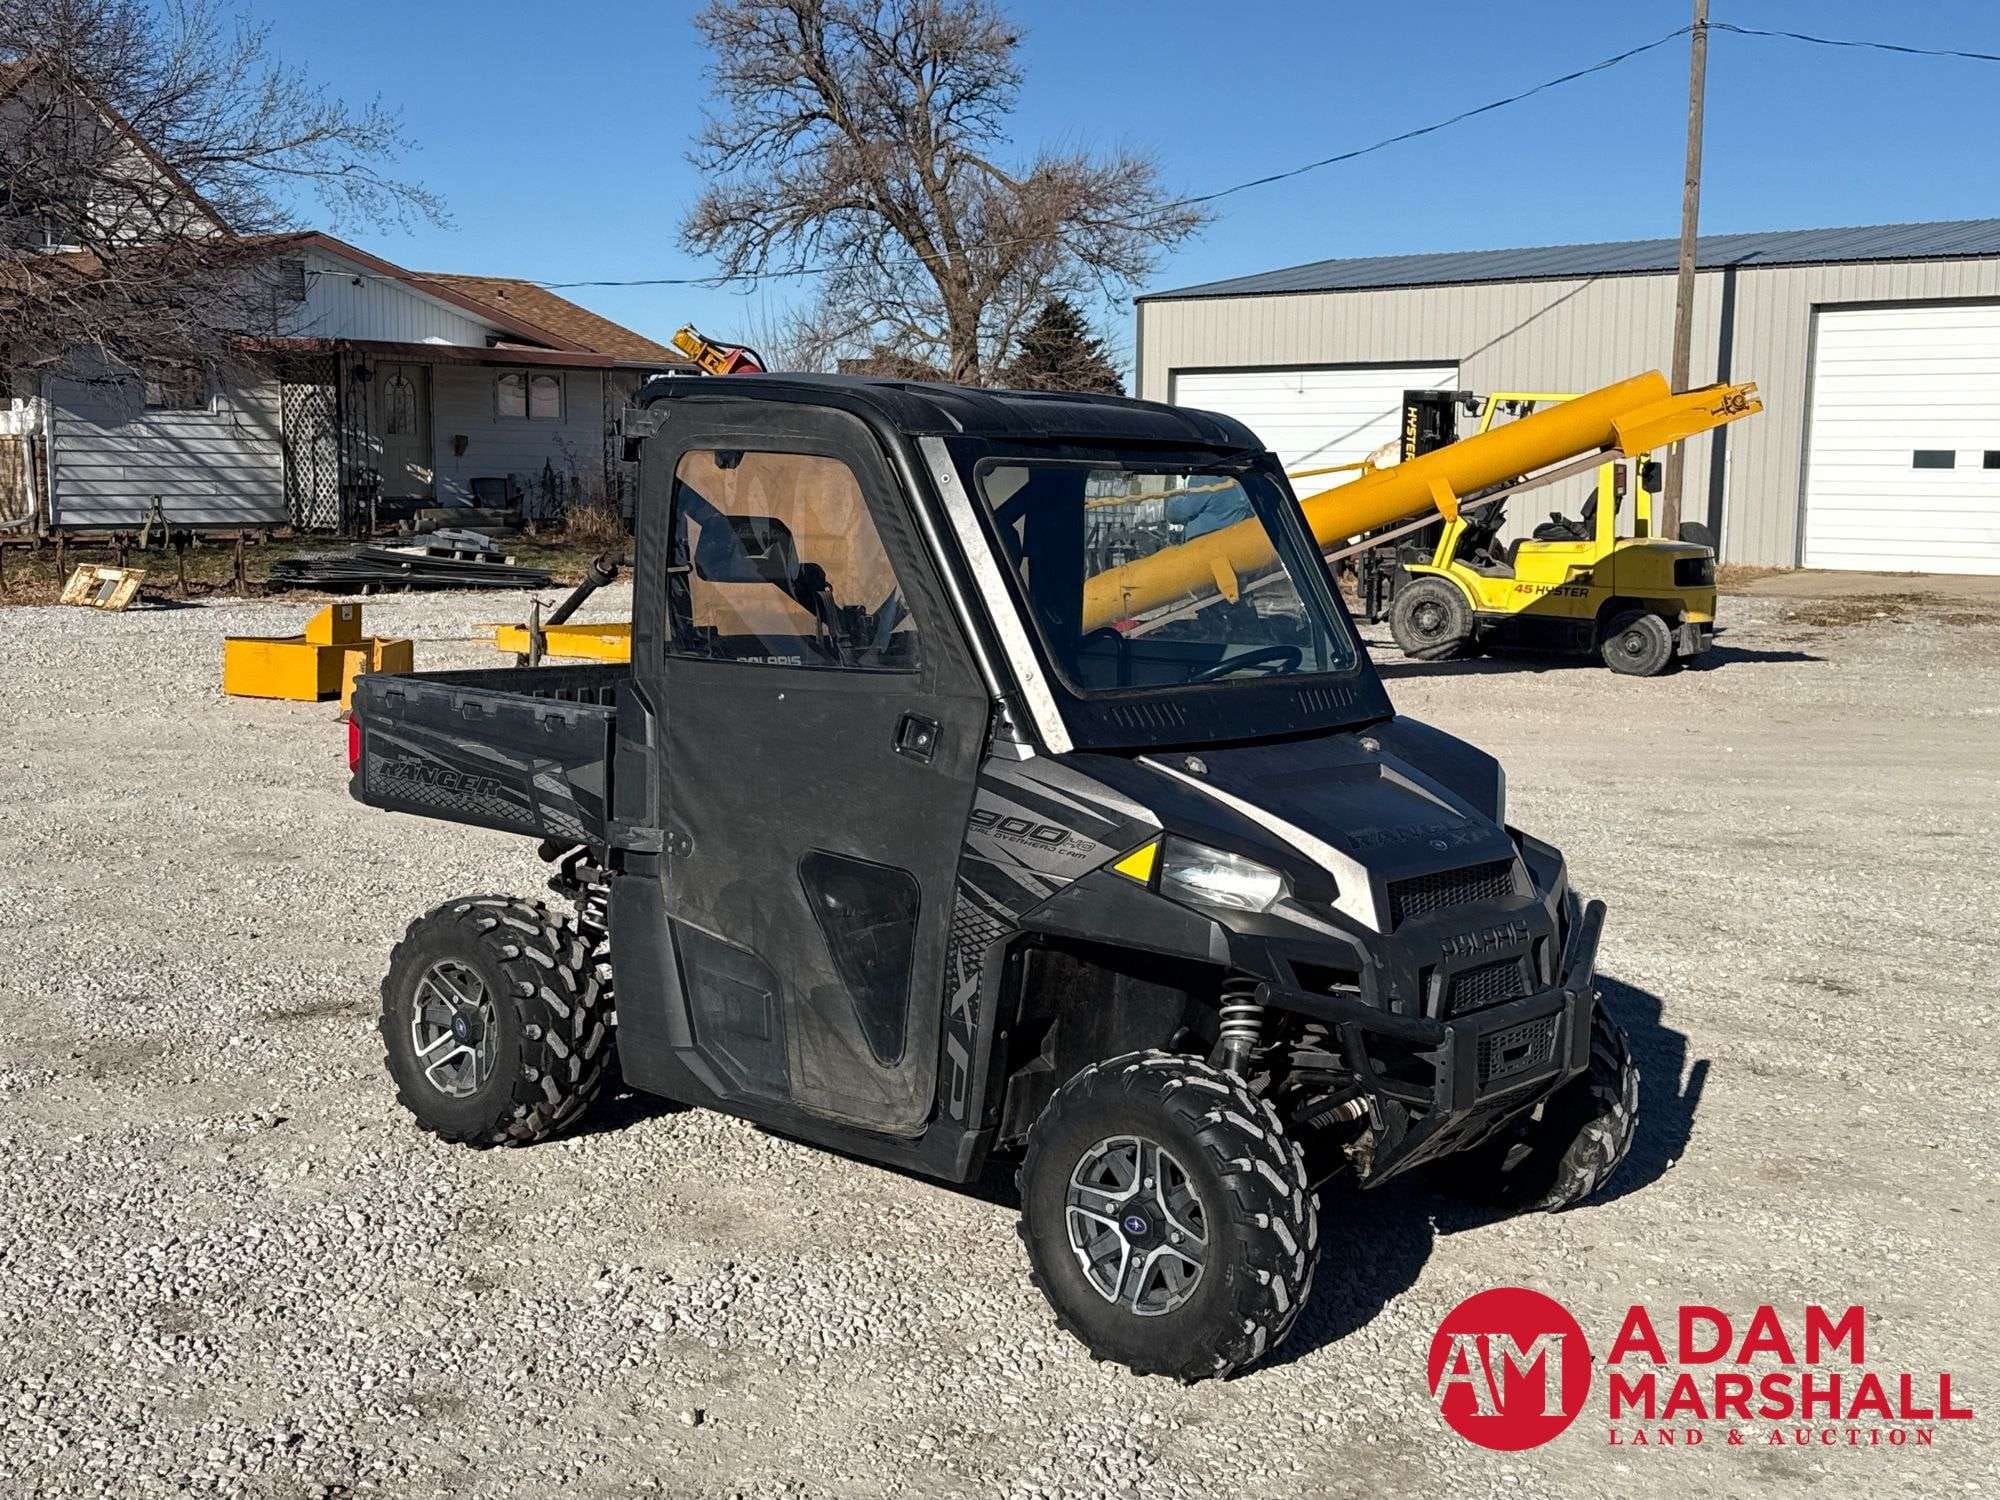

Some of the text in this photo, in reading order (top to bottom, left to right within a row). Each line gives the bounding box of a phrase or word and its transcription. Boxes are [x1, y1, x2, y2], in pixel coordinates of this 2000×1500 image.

[1513, 583, 1590, 598] 45 HYSTER
[379, 757, 503, 798] RANGER
[969, 808, 1071, 844] 900
[1441, 919, 1530, 964] POLARIS
